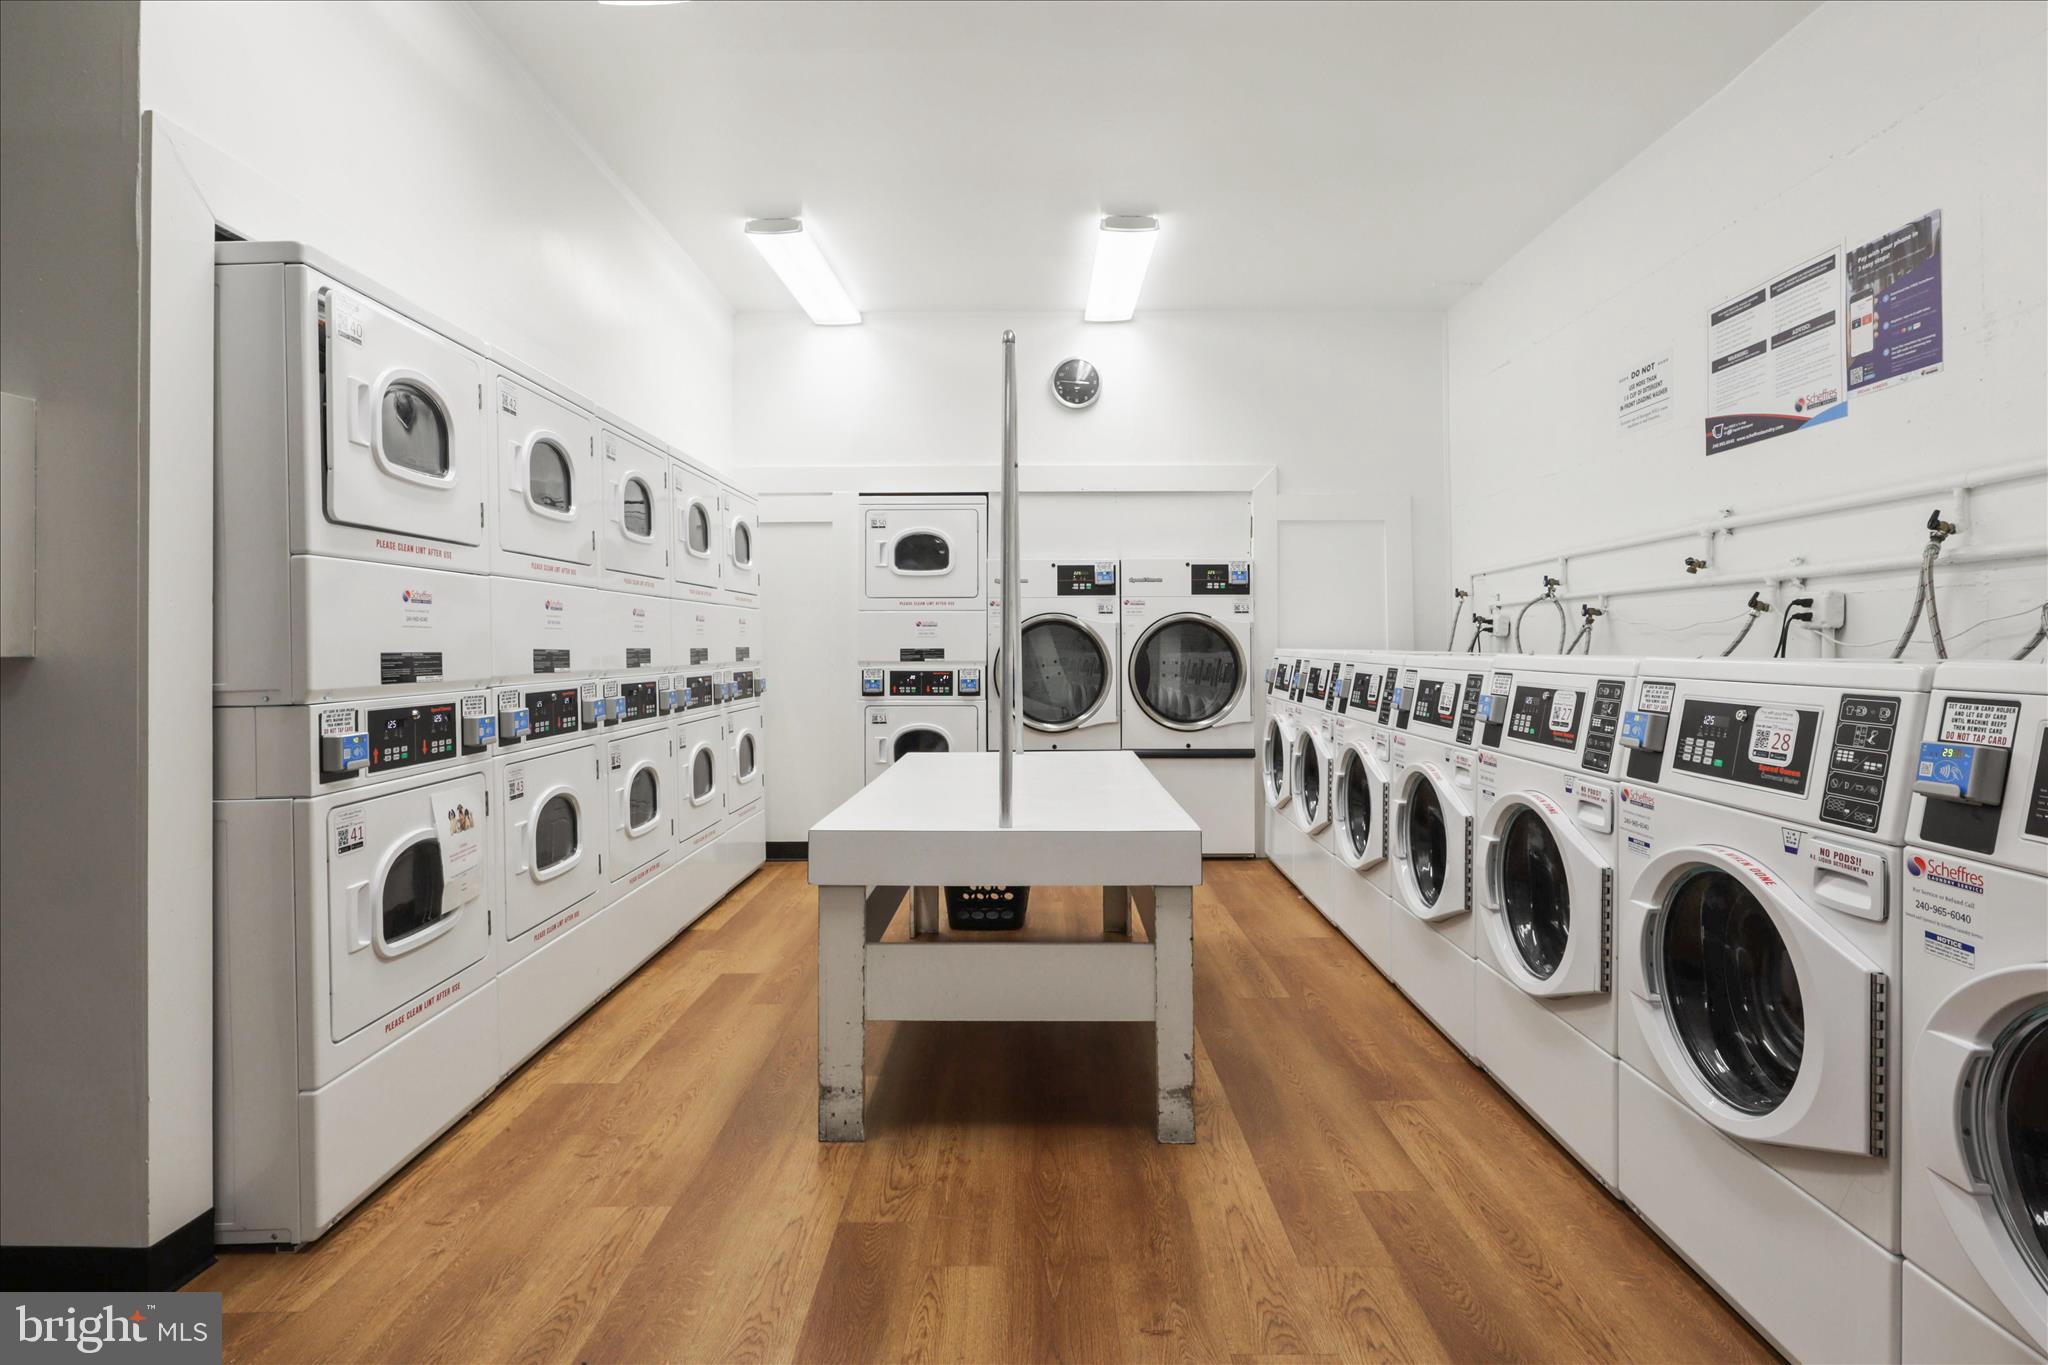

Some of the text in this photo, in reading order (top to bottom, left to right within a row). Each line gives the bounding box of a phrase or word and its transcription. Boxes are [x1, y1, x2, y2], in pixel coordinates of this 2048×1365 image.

[1868, 249, 1880, 258] with
[1881, 243, 1893, 254] your
[1894, 235, 1911, 248] phone
[351, 322, 362, 338] 40
[1631, 362, 1655, 379] DO NOT
[509, 398, 516, 410] 42
[1806, 388, 1837, 404] Scheffres
[376, 539, 452, 560] PLEASE CLEAN LINT AFTER USE
[1561, 708, 1572, 720] 27
[1771, 732, 1791, 751] 28
[1946, 731, 2007, 745] DO NOT TAP CARD
[1942, 748, 1953, 757] 29
[516, 781, 524, 792] 43
[1630, 789, 1655, 806] Scheffres
[350, 826, 364, 841] 41
[1820, 848, 1862, 866] NO PODS!!
[1818, 857, 1832, 865] LIQUID
[1833, 860, 1860, 872] DETERGENT
[1861, 868, 1874, 877] ONLY
[1928, 859, 1984, 887] Scheffres
[1750, 868, 1777, 886] DONE
[1928, 875, 1983, 894] LAUNDRY SERVICE
[1915, 899, 1972, 924] 240-965-6040
[1936, 935, 1962, 949] NOTICE
[385, 982, 461, 1033] PLEASE CLEAN LINT AFTER USE
